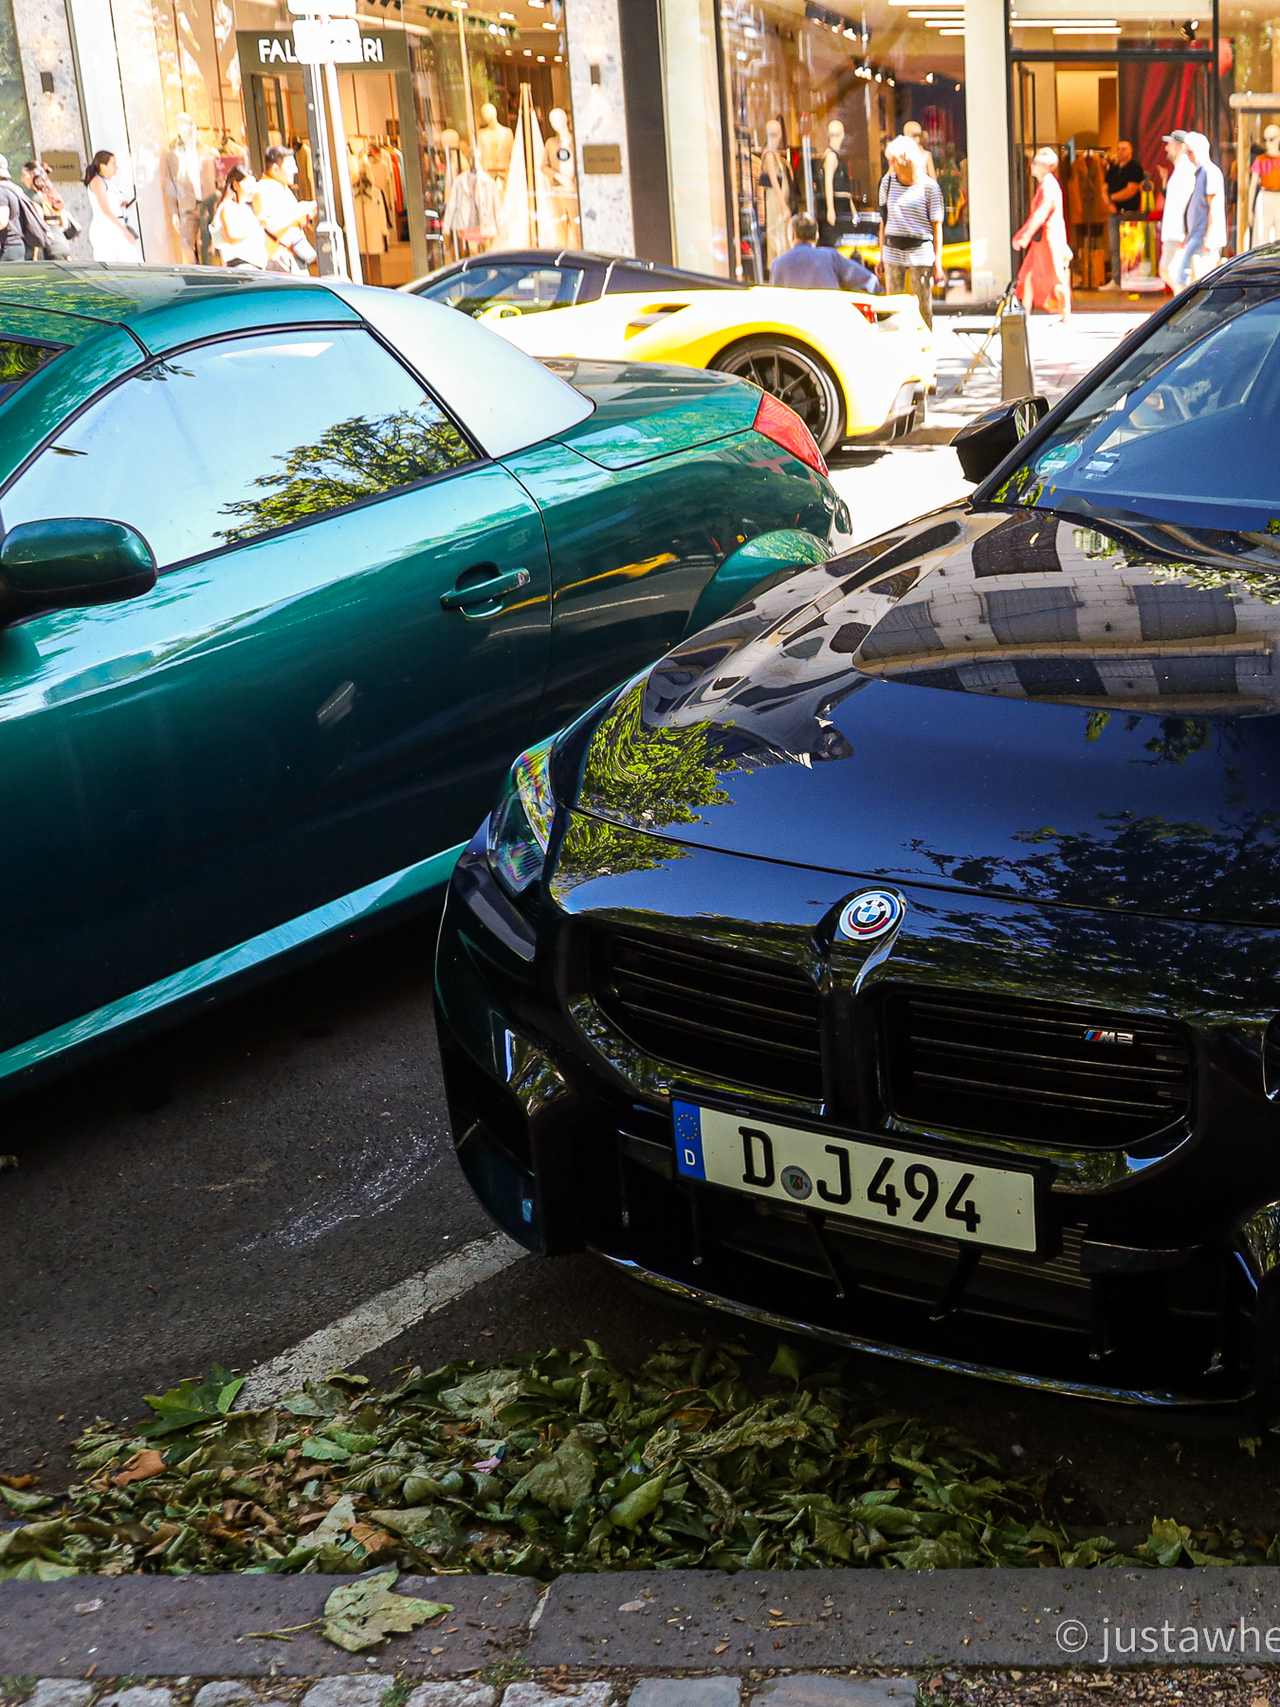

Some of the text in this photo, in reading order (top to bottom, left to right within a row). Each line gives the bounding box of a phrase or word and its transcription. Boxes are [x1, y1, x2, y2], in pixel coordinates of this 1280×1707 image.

[258, 37, 384, 64] FALRI
[1099, 1030, 1134, 1046] M2
[684, 1149, 696, 1166] D
[738, 1125, 776, 1188] D
